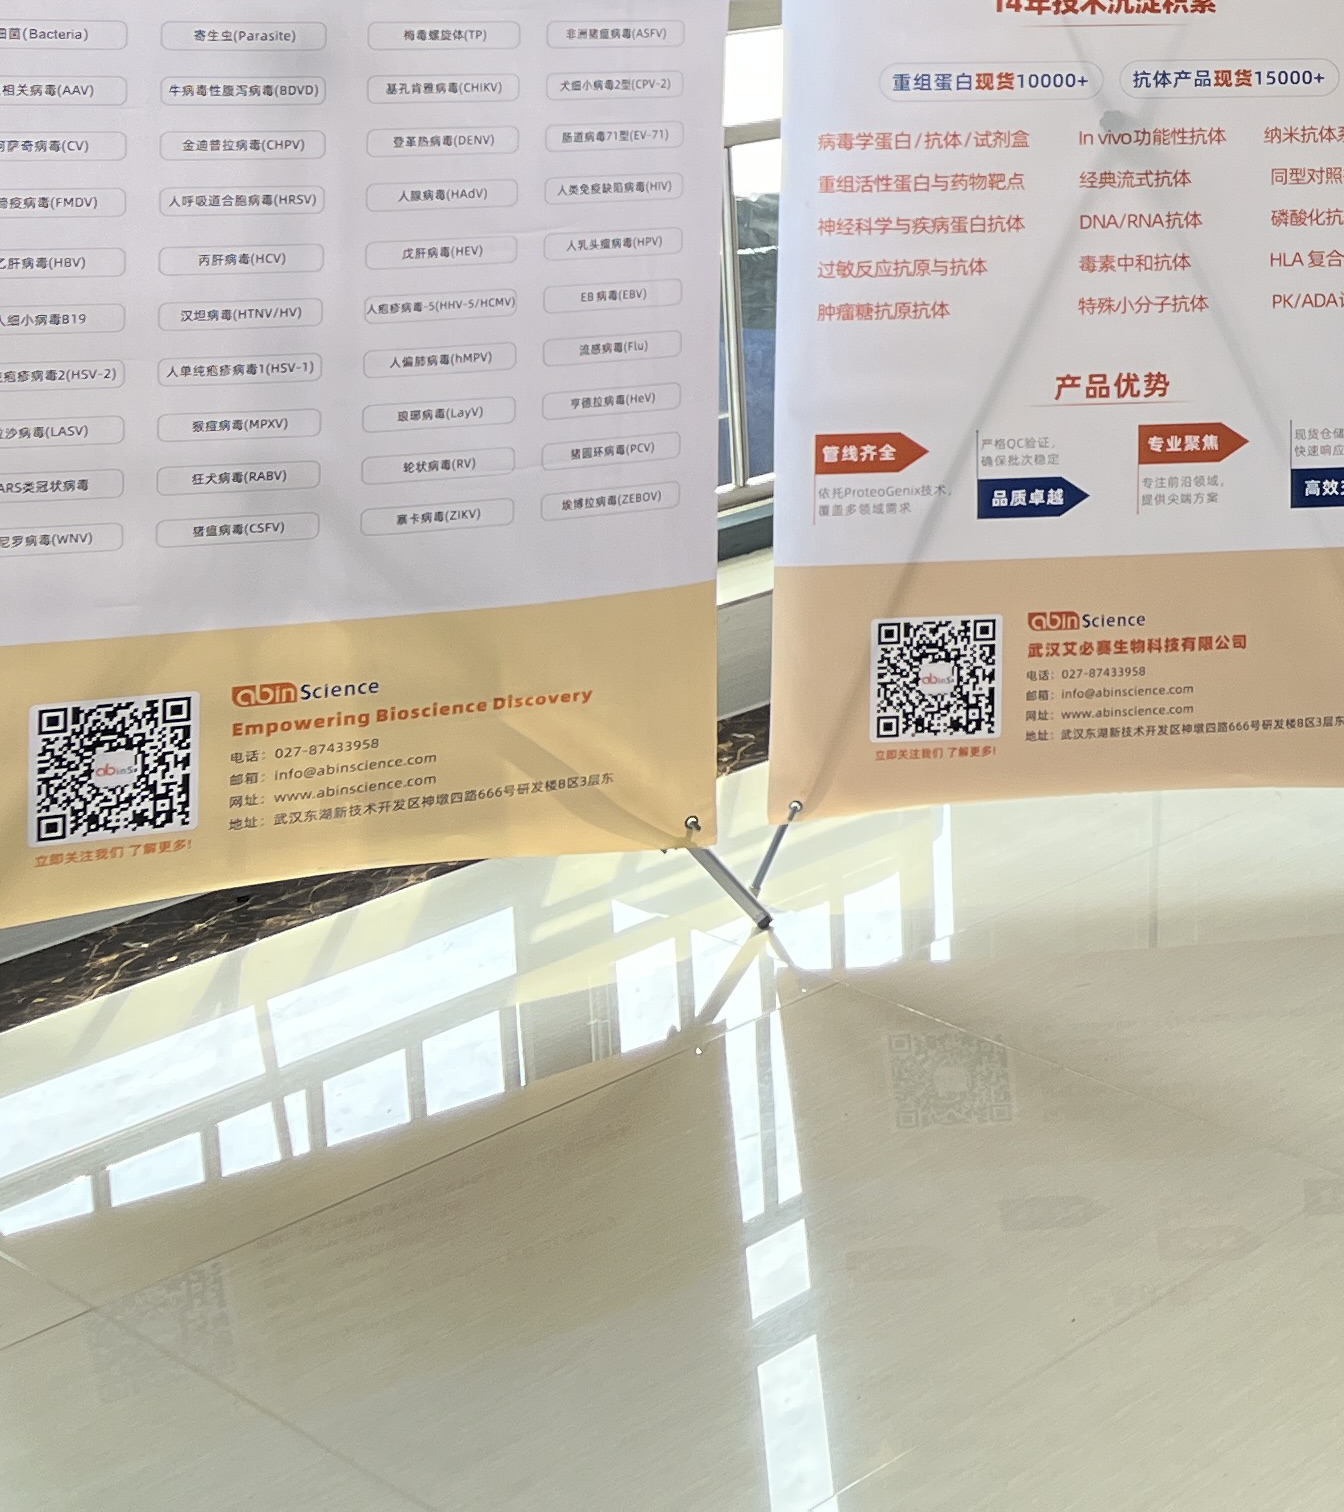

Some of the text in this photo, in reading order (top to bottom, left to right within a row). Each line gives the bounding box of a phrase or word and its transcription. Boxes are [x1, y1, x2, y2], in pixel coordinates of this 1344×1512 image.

[891, 72, 1090, 92] 重组蛋白现货10000+
[1131, 68, 1326, 89] 抗体产品现货15000+
[817, 172, 1026, 194] 重组活性蛋白与药物靶点
[1079, 169, 1192, 190] 经典流式抗体
[817, 214, 1026, 237] 神经科学与疾病蛋白抗体
[1079, 211, 1203, 230] DNA/RNA抗体
[817, 257, 988, 279] 过敏反应抗原与抗体
[1078, 252, 1192, 273] 毒素中和抗体
[1269, 251, 1304, 268] HLA
[817, 300, 951, 322] 肿瘤糖抗原抗体
[1078, 294, 1210, 316] 特殊小分子抗体
[1054, 371, 1171, 401] 产品优势
[821, 443, 897, 464] 管线齐全
[232, 688, 594, 737] Empowering Bioscience Discovery
